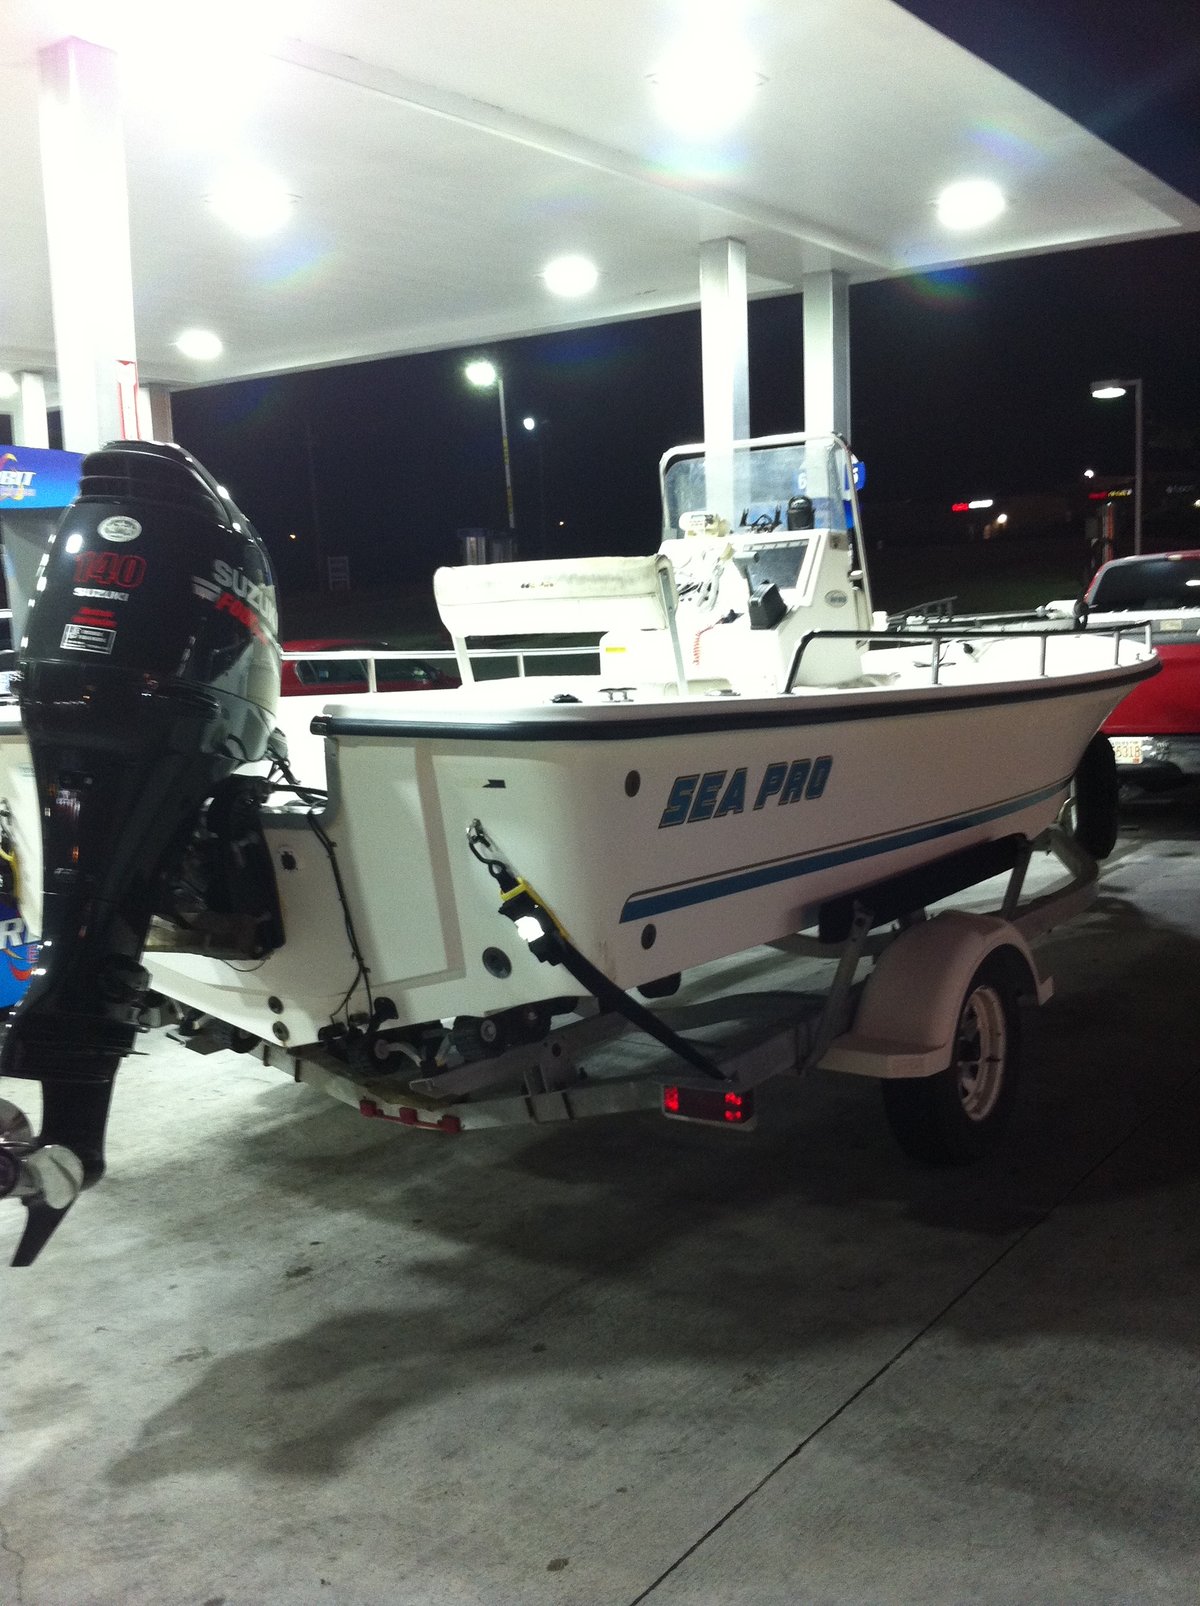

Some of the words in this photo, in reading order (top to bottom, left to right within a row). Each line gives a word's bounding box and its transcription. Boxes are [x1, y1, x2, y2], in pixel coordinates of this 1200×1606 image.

[0, 470, 37, 486] BIT
[74, 551, 148, 590] 140
[72, 587, 130, 602] SUZUKI
[658, 767, 748, 829] SEA
[753, 755, 833, 811] PRO
